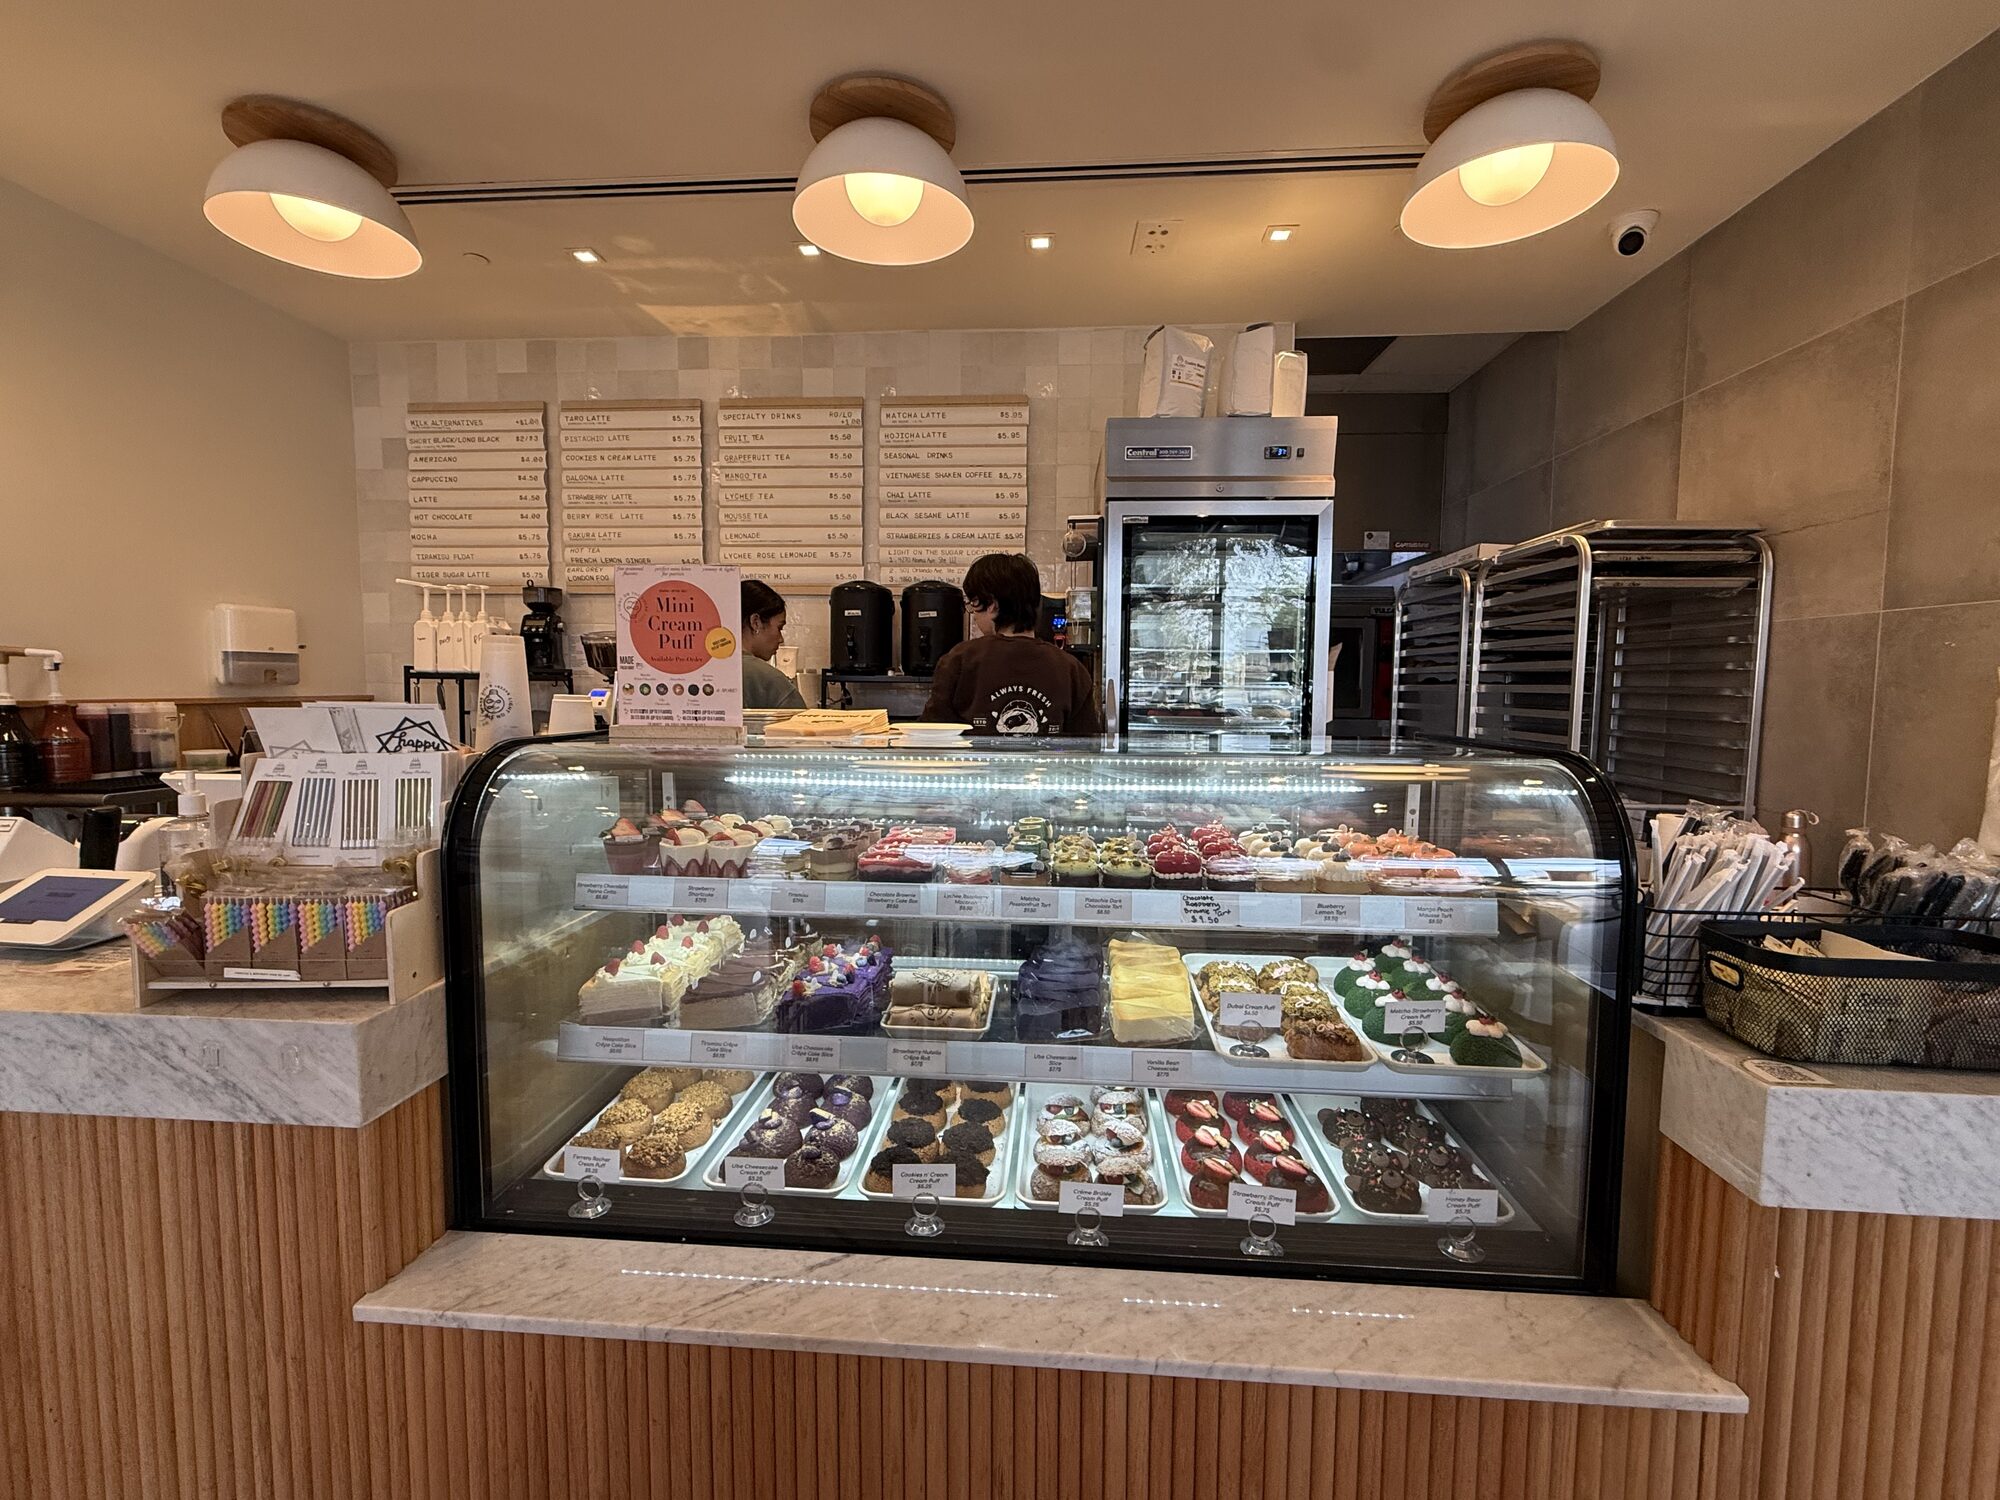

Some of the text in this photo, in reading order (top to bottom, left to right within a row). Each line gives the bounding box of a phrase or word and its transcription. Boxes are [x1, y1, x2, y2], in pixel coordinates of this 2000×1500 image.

[723, 413, 766, 421] SPECIALTY
[886, 411, 1023, 419] MATCHA LATTE $5.95
[564, 435, 604, 443] PISTACHIO
[723, 434, 747, 442] FRUIT
[921, 431, 947, 439] LATTE
[829, 452, 852, 460] $5.50
[884, 452, 920, 460] SEASONAL
[566, 474, 598, 482] DALGONA
[935, 471, 962, 479] SHAKEN
[965, 471, 993, 479] COFFEE
[998, 472, 1023, 480] $5.75
[886, 491, 905, 499] CHAI
[724, 512, 751, 520] MOUSSE
[998, 512, 1020, 520] $5.95
[725, 532, 760, 540] LEMONADE
[519, 552, 541, 560] $5.75
[522, 571, 543, 579] $5.75
[656, 596, 695, 613] Mini
[648, 615, 703, 632] Cream
[659, 633, 696, 650] Puff
[619, 655, 635, 665] MADE
[650, 655, 704, 663] Available Pre-Order
[991, 685, 1052, 707] ALWAYS FRESH
[1185, 901, 1221, 909] Raspberry
[1316, 902, 1345, 910] Blueberry
[1213, 908, 1232, 917] Tart
[1045, 1054, 1077, 1062] Cheesecake
[1146, 1059, 1165, 1067] Vanilla
[1231, 1190, 1293, 1203] Strawberry S'mores
[1244, 1198, 1281, 1208] Cream Puff
